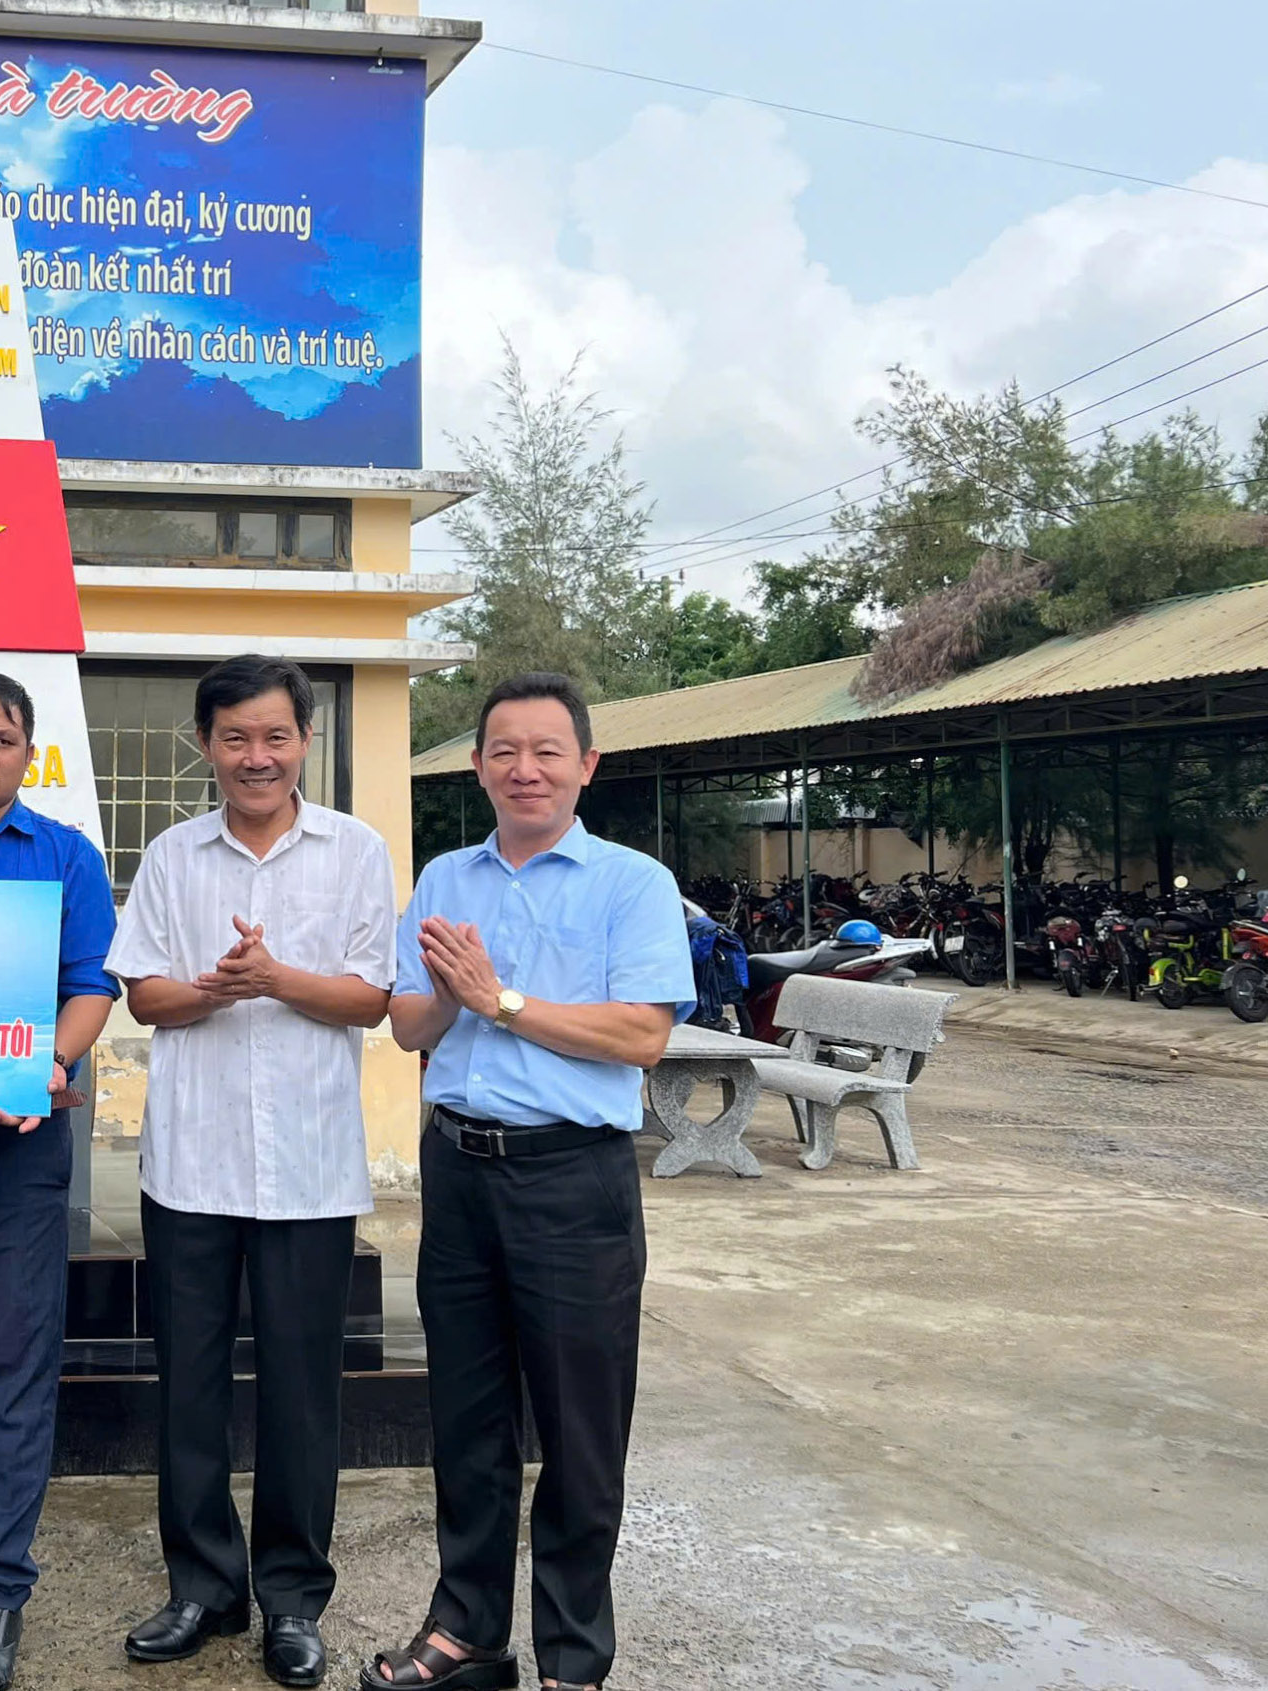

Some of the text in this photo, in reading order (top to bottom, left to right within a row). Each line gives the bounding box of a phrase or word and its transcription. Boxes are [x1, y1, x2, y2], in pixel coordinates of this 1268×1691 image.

[47, 70, 253, 143] trường
[27, 184, 74, 226] dục
[81, 188, 138, 231] hiện
[143, 190, 193, 235] đại,
[199, 192, 228, 238] kỷ
[235, 199, 312, 242] cương
[18, 249, 82, 292] đoàn
[88, 252, 131, 294] kết
[136, 254, 196, 297] nhất
[202, 258, 233, 298] trí
[30, 316, 85, 361] diện
[90, 316, 123, 361] về
[128, 322, 194, 363] nhân
[198, 324, 256, 365] cách
[261, 326, 292, 366] và
[298, 326, 328, 369] trí
[333, 331, 385, 376] tuệ.
